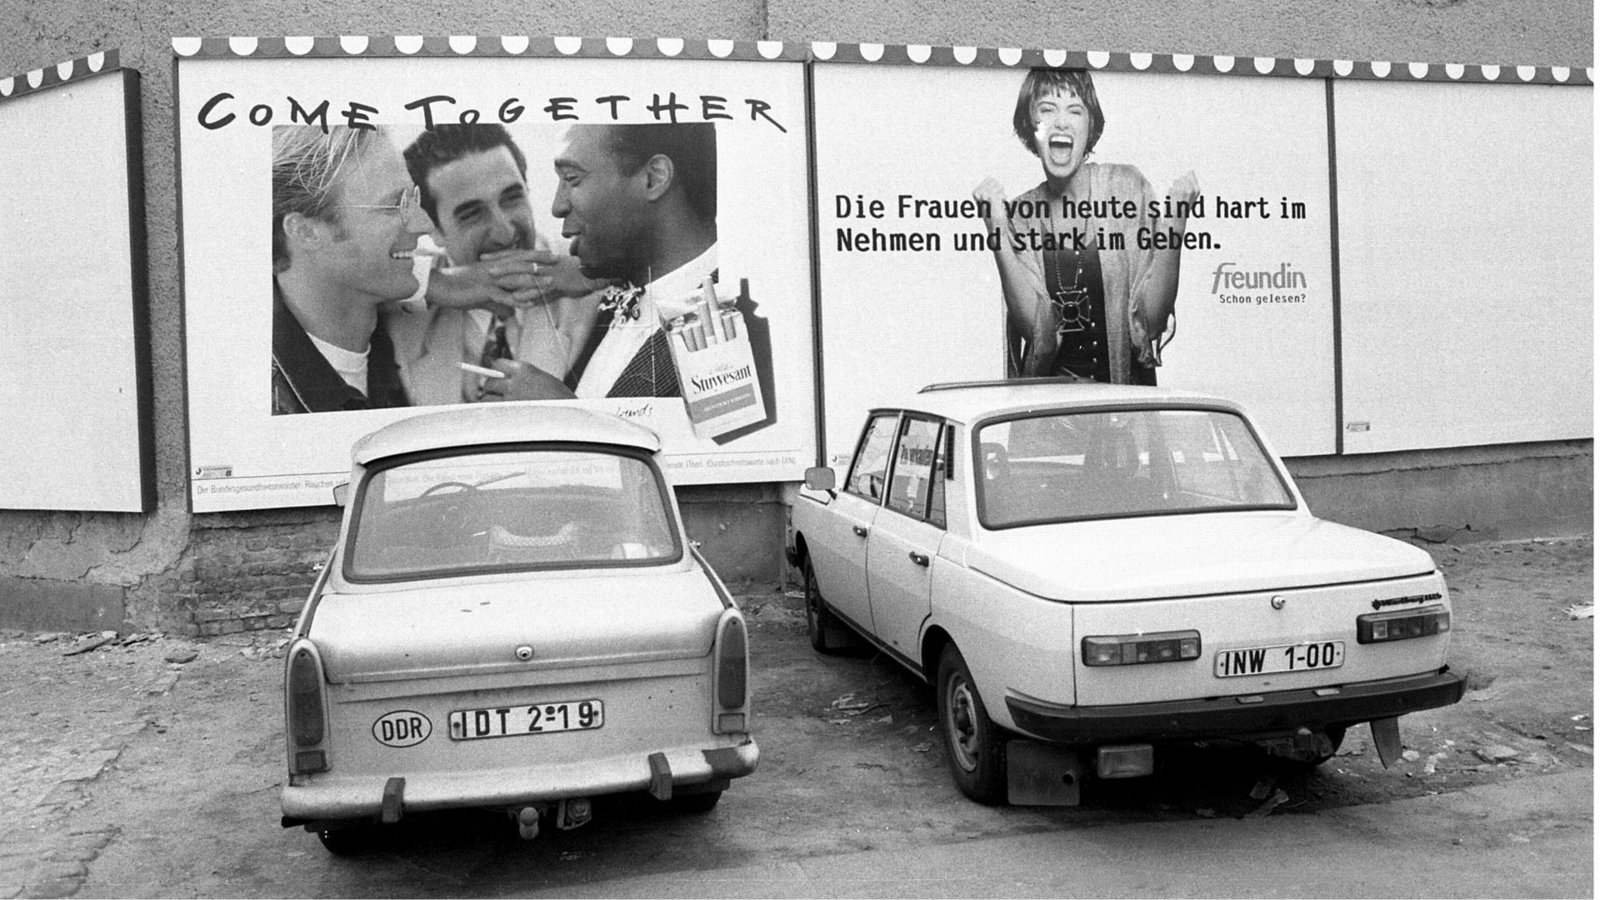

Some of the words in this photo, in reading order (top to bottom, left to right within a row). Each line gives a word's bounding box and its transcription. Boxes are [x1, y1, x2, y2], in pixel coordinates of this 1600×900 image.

[198, 92, 379, 134] COME
[404, 92, 787, 133] TOGETHER
[836, 195, 885, 218] Die
[898, 195, 991, 218] Frauen
[1004, 199, 1050, 218] von
[1062, 195, 1137, 218] heute
[1148, 195, 1205, 218] sind
[1216, 196, 1270, 218] hart
[1280, 197, 1306, 219] im
[837, 228, 941, 251] Nehmen
[954, 227, 1000, 251] und
[1013, 227, 1086, 251] stark
[1097, 227, 1125, 250] im
[1137, 227, 1221, 250] Geben.
[1211, 262, 1307, 294] freundin
[1219, 294, 1251, 303] Schon
[1256, 293, 1306, 305] gelesen?
[691, 364, 752, 394] Stuyvesant
[1225, 649, 1266, 675] INW
[1284, 642, 1334, 670] 1-00
[381, 717, 423, 741] DDR
[461, 708, 510, 737] IDT
